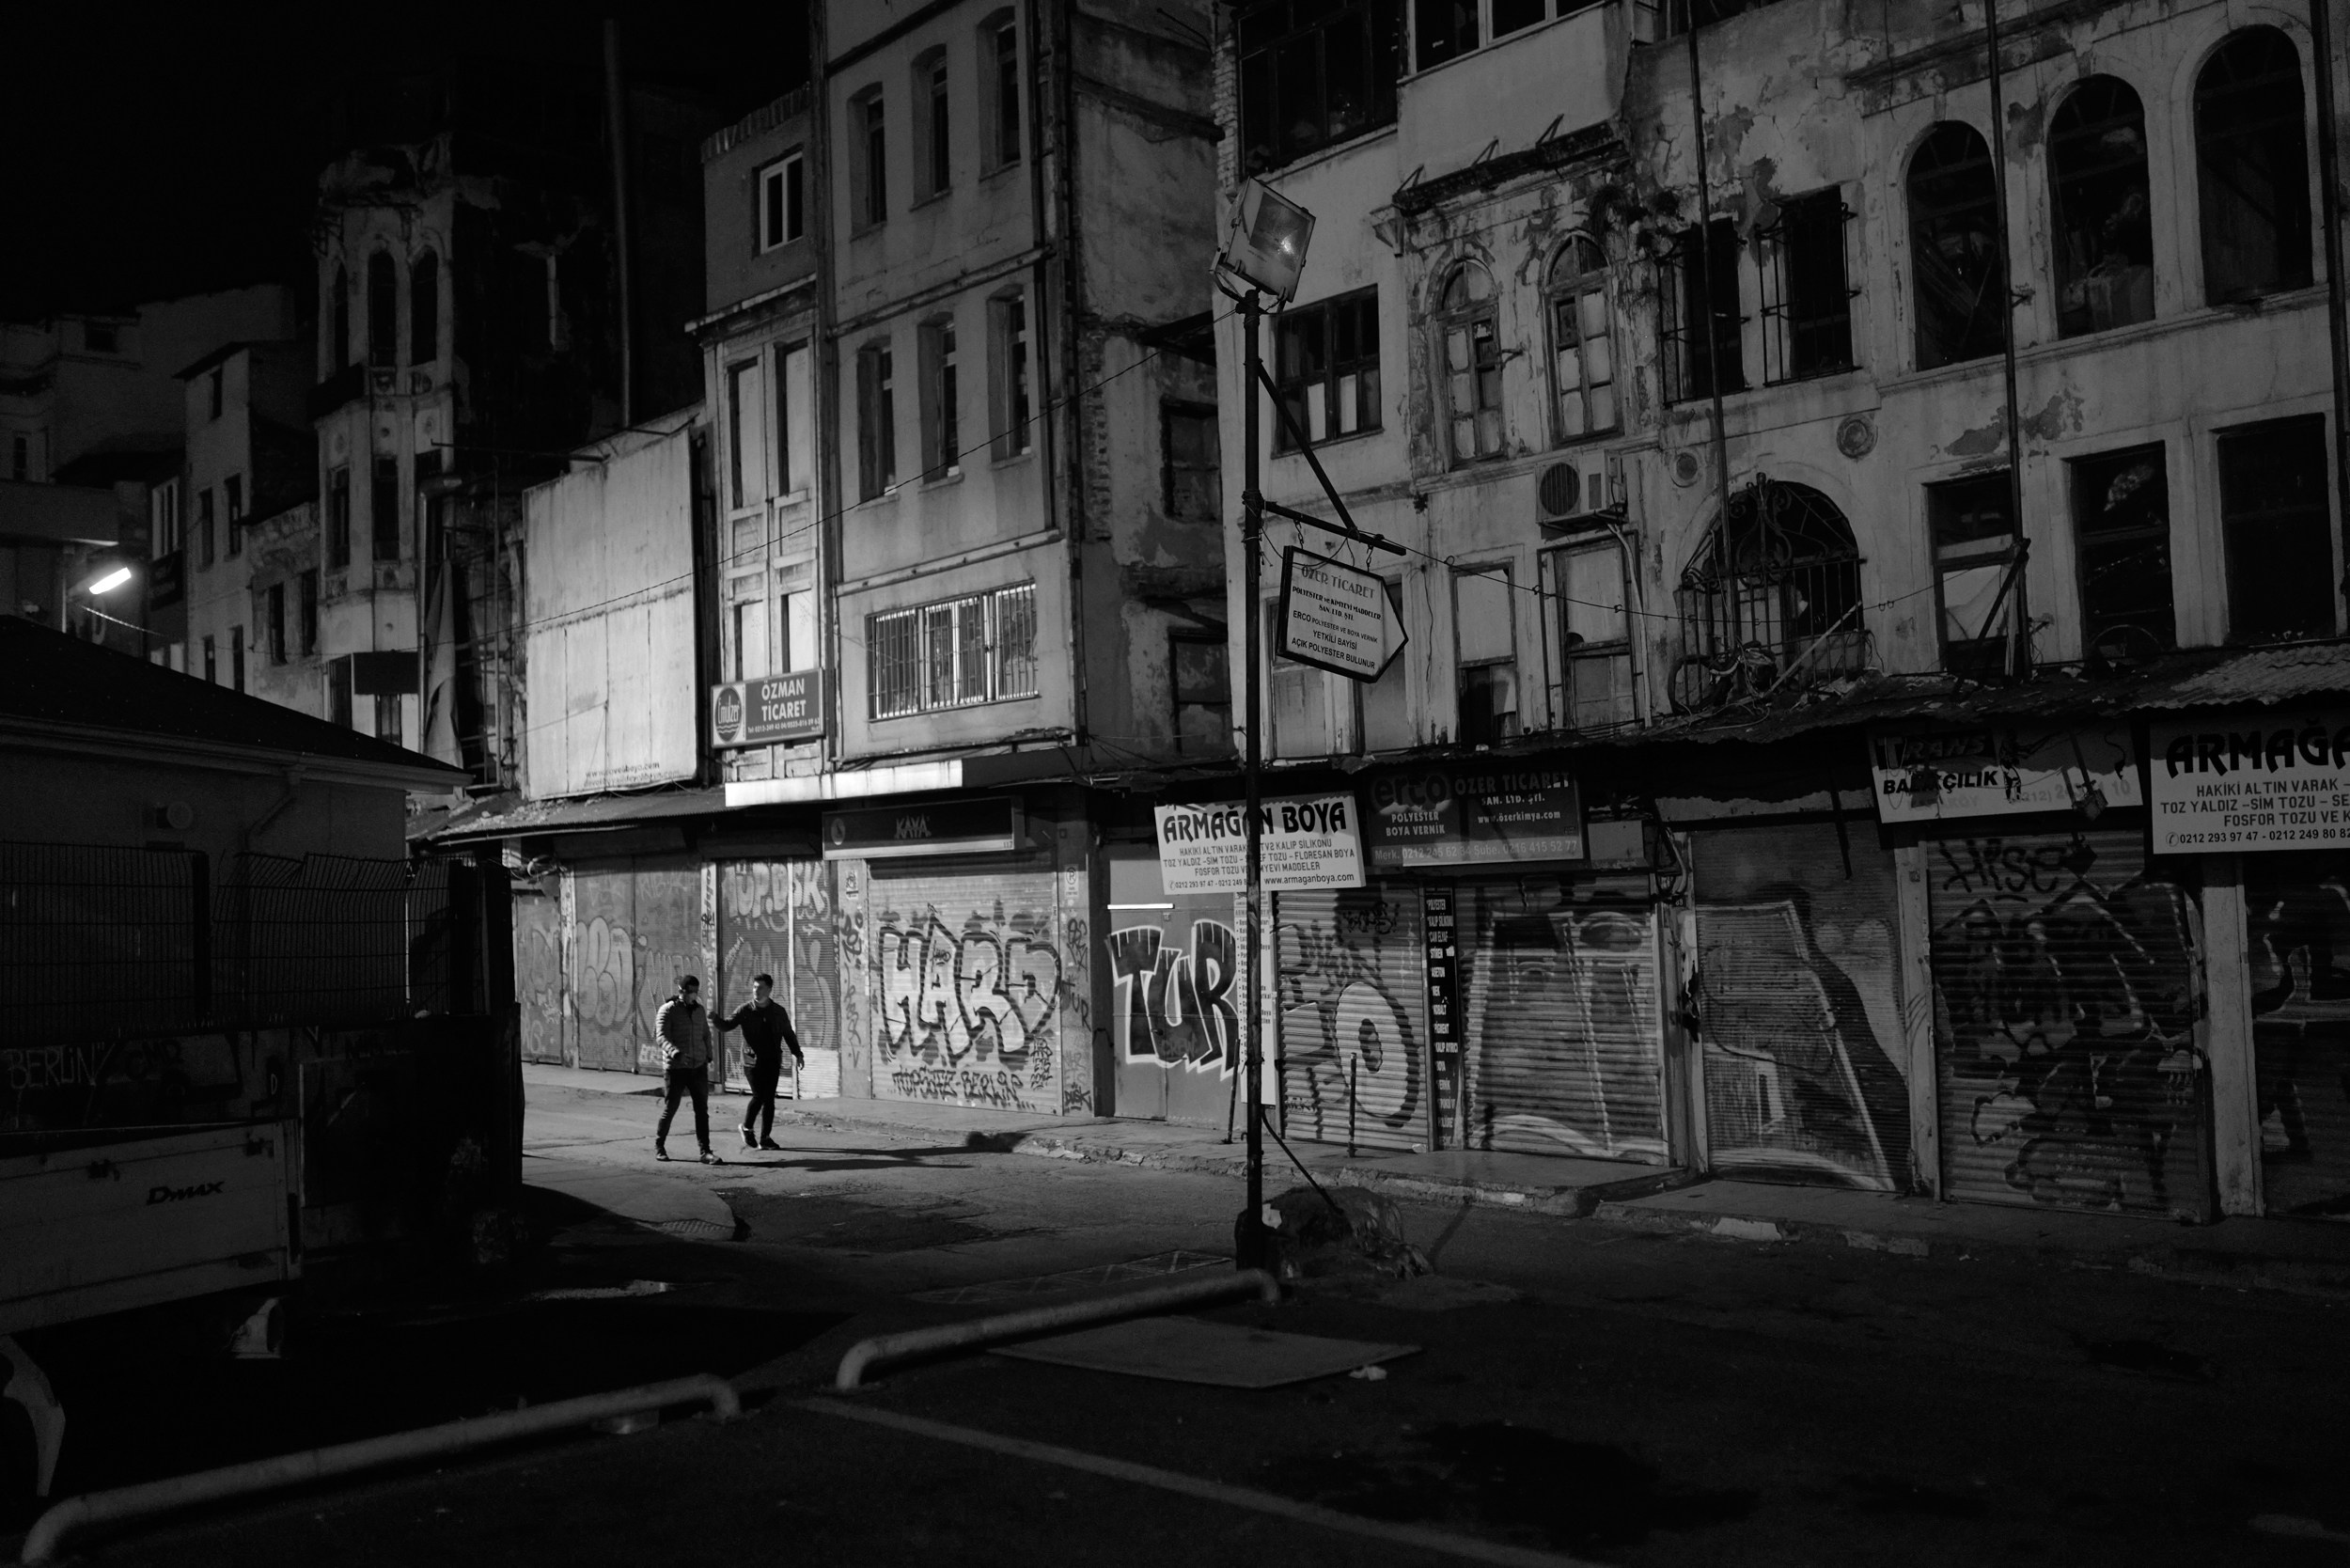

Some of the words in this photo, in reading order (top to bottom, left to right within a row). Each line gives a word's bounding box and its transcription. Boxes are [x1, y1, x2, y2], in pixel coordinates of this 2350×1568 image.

[1331, 575, 1375, 599] TİCARET
[1292, 586, 1324, 602] POLYESTER
[1331, 599, 1353, 611] KİMYEVİ
[1354, 606, 1381, 620] MADDELER
[1332, 608, 1343, 618] LTD.
[1293, 611, 1311, 622] ERCO
[1312, 618, 1340, 631] POLYESTER
[1347, 629, 1360, 637] BOYA
[1361, 633, 1377, 643] VERNİK
[1313, 630, 1337, 644] YETKİLİ
[1338, 638, 1357, 650] BAYİSİ
[1292, 637, 1308, 649] AÇIK
[1308, 642, 1344, 660] POLYESTER
[1346, 653, 1375, 669] BULUNUR
[761, 678, 805, 700] ÖZMAN
[761, 699, 807, 721] TİCARET
[1454, 775, 1496, 795] ÖZER
[1502, 767, 1570, 792] TİCARET
[1883, 772, 1998, 794] BAÇILIK
[2197, 782, 2241, 797] HAKİKİ
[2245, 781, 2287, 795] ALTIN
[2291, 778, 2339, 792] VARAK
[2161, 802, 2186, 814] TOZ
[2191, 800, 2237, 812] YALDIZ
[2279, 796, 2315, 808] TOZU
[1163, 805, 1274, 843] ARMAĞN
[1281, 802, 1347, 834] BOYA
[1391, 810, 1440, 823] POLYESTER
[2224, 815, 2275, 826] FOSFOR
[2280, 813, 2316, 824] TOZU
[2321, 811, 2339, 823] VE
[1386, 826, 1411, 838] BOYA
[1413, 823, 1446, 836] VERNİK
[2180, 834, 2204, 843] 0212
[2208, 833, 2227, 842] 293
[2230, 832, 2242, 841] 97
[2246, 832, 2258, 840] 47
[2269, 830, 2295, 840] 0212
[2299, 829, 2318, 839] 249
[2323, 829, 2336, 839] 80
[2341, 829, 2350, 838] 82
[1180, 846, 1201, 856] HAKİKİ
[1203, 845, 1223, 855] ALTIN
[1225, 844, 1246, 853] VARAK
[1277, 841, 1297, 850] KALIP
[1299, 839, 1332, 848] SİLİKONU
[1374, 850, 1400, 860] Merk.
[1402, 848, 1425, 859] 0212
[1529, 841, 1547, 853] 415
[1550, 841, 1563, 852] 52
[1565, 840, 1577, 851] 77
[1164, 859, 1176, 868] TOZ
[1178, 857, 1201, 866] YALDIZ
[1220, 855, 1238, 864] TOZU
[1269, 853, 1287, 861] TOZU
[1294, 851, 1332, 860] FLORESAN
[1335, 849, 1355, 857] BOYA
[1195, 868, 1219, 876] FOSFOR
[1283, 862, 1320, 871] MADDELER
[1264, 873, 1355, 885] www.armaganboya.com
